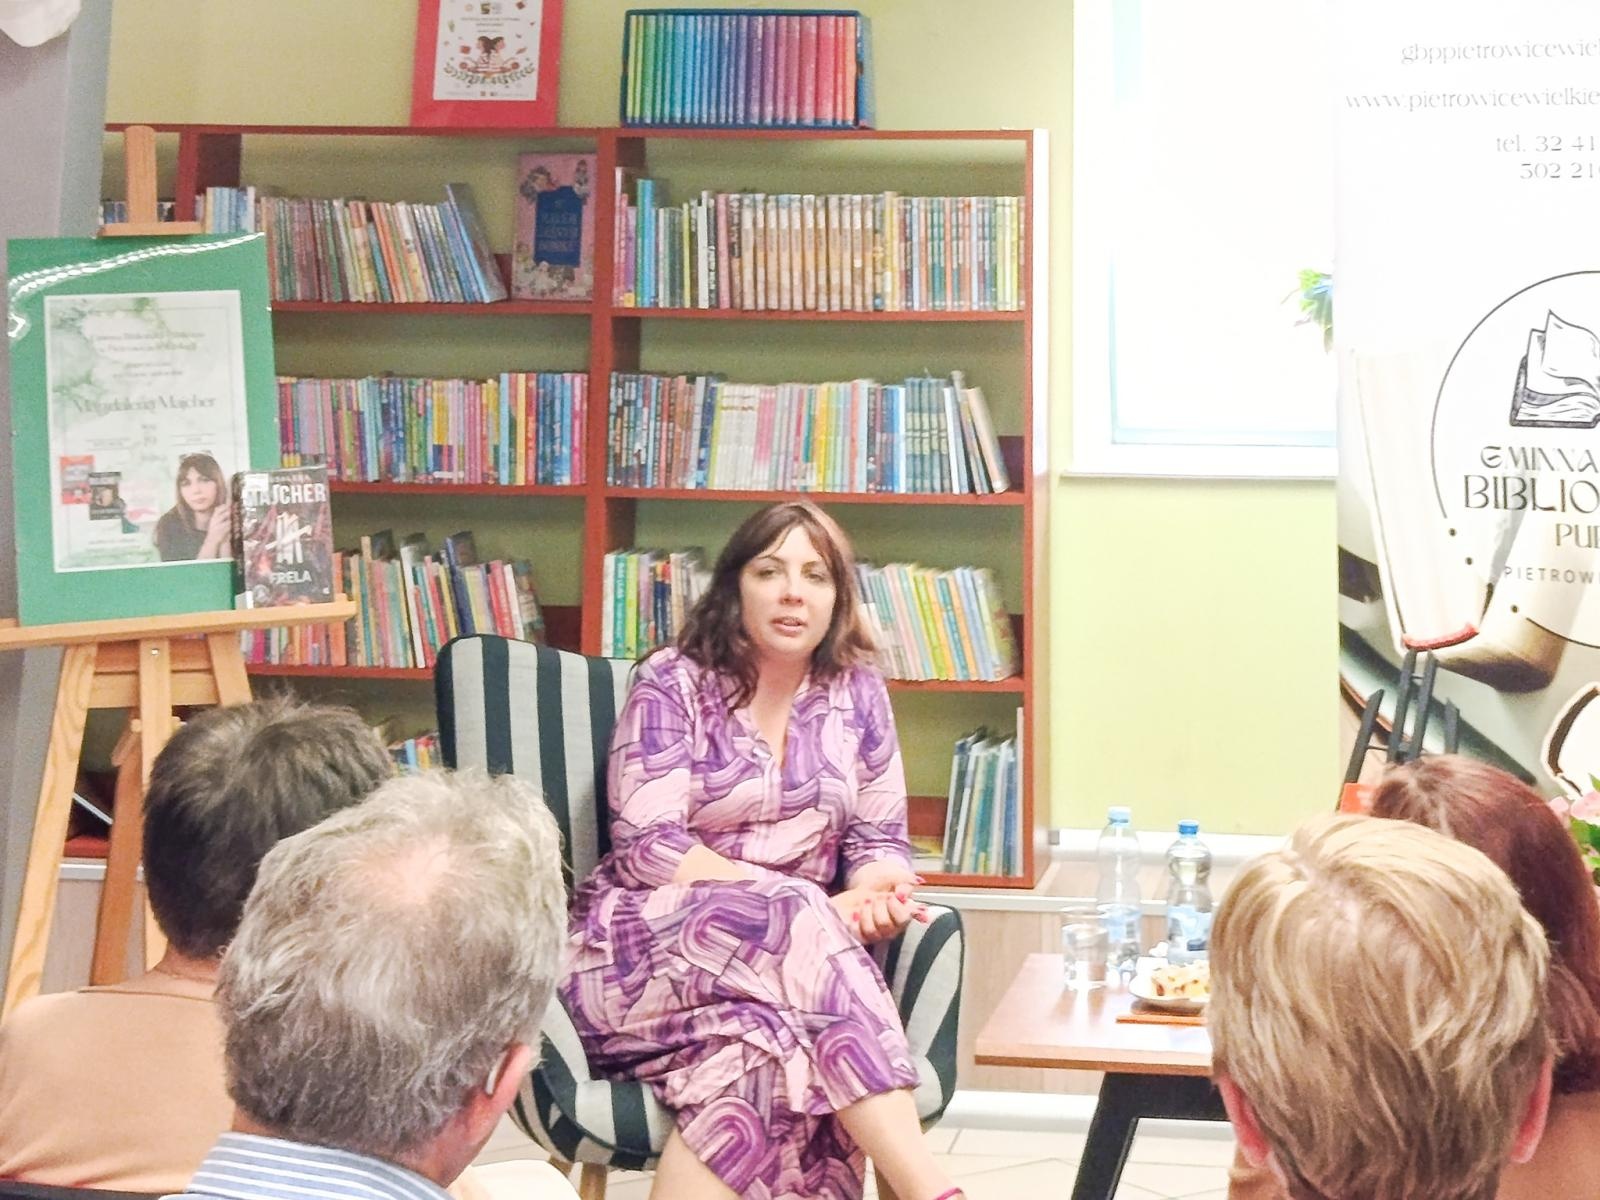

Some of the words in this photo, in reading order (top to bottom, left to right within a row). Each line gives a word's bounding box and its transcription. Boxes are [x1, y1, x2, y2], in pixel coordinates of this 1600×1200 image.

[1496, 134, 1526, 153] tel.
[1535, 136, 1563, 153] 32
[1520, 162, 1562, 180] 502
[1570, 162, 1600, 180] 21
[1464, 474, 1600, 514] BIBLIO
